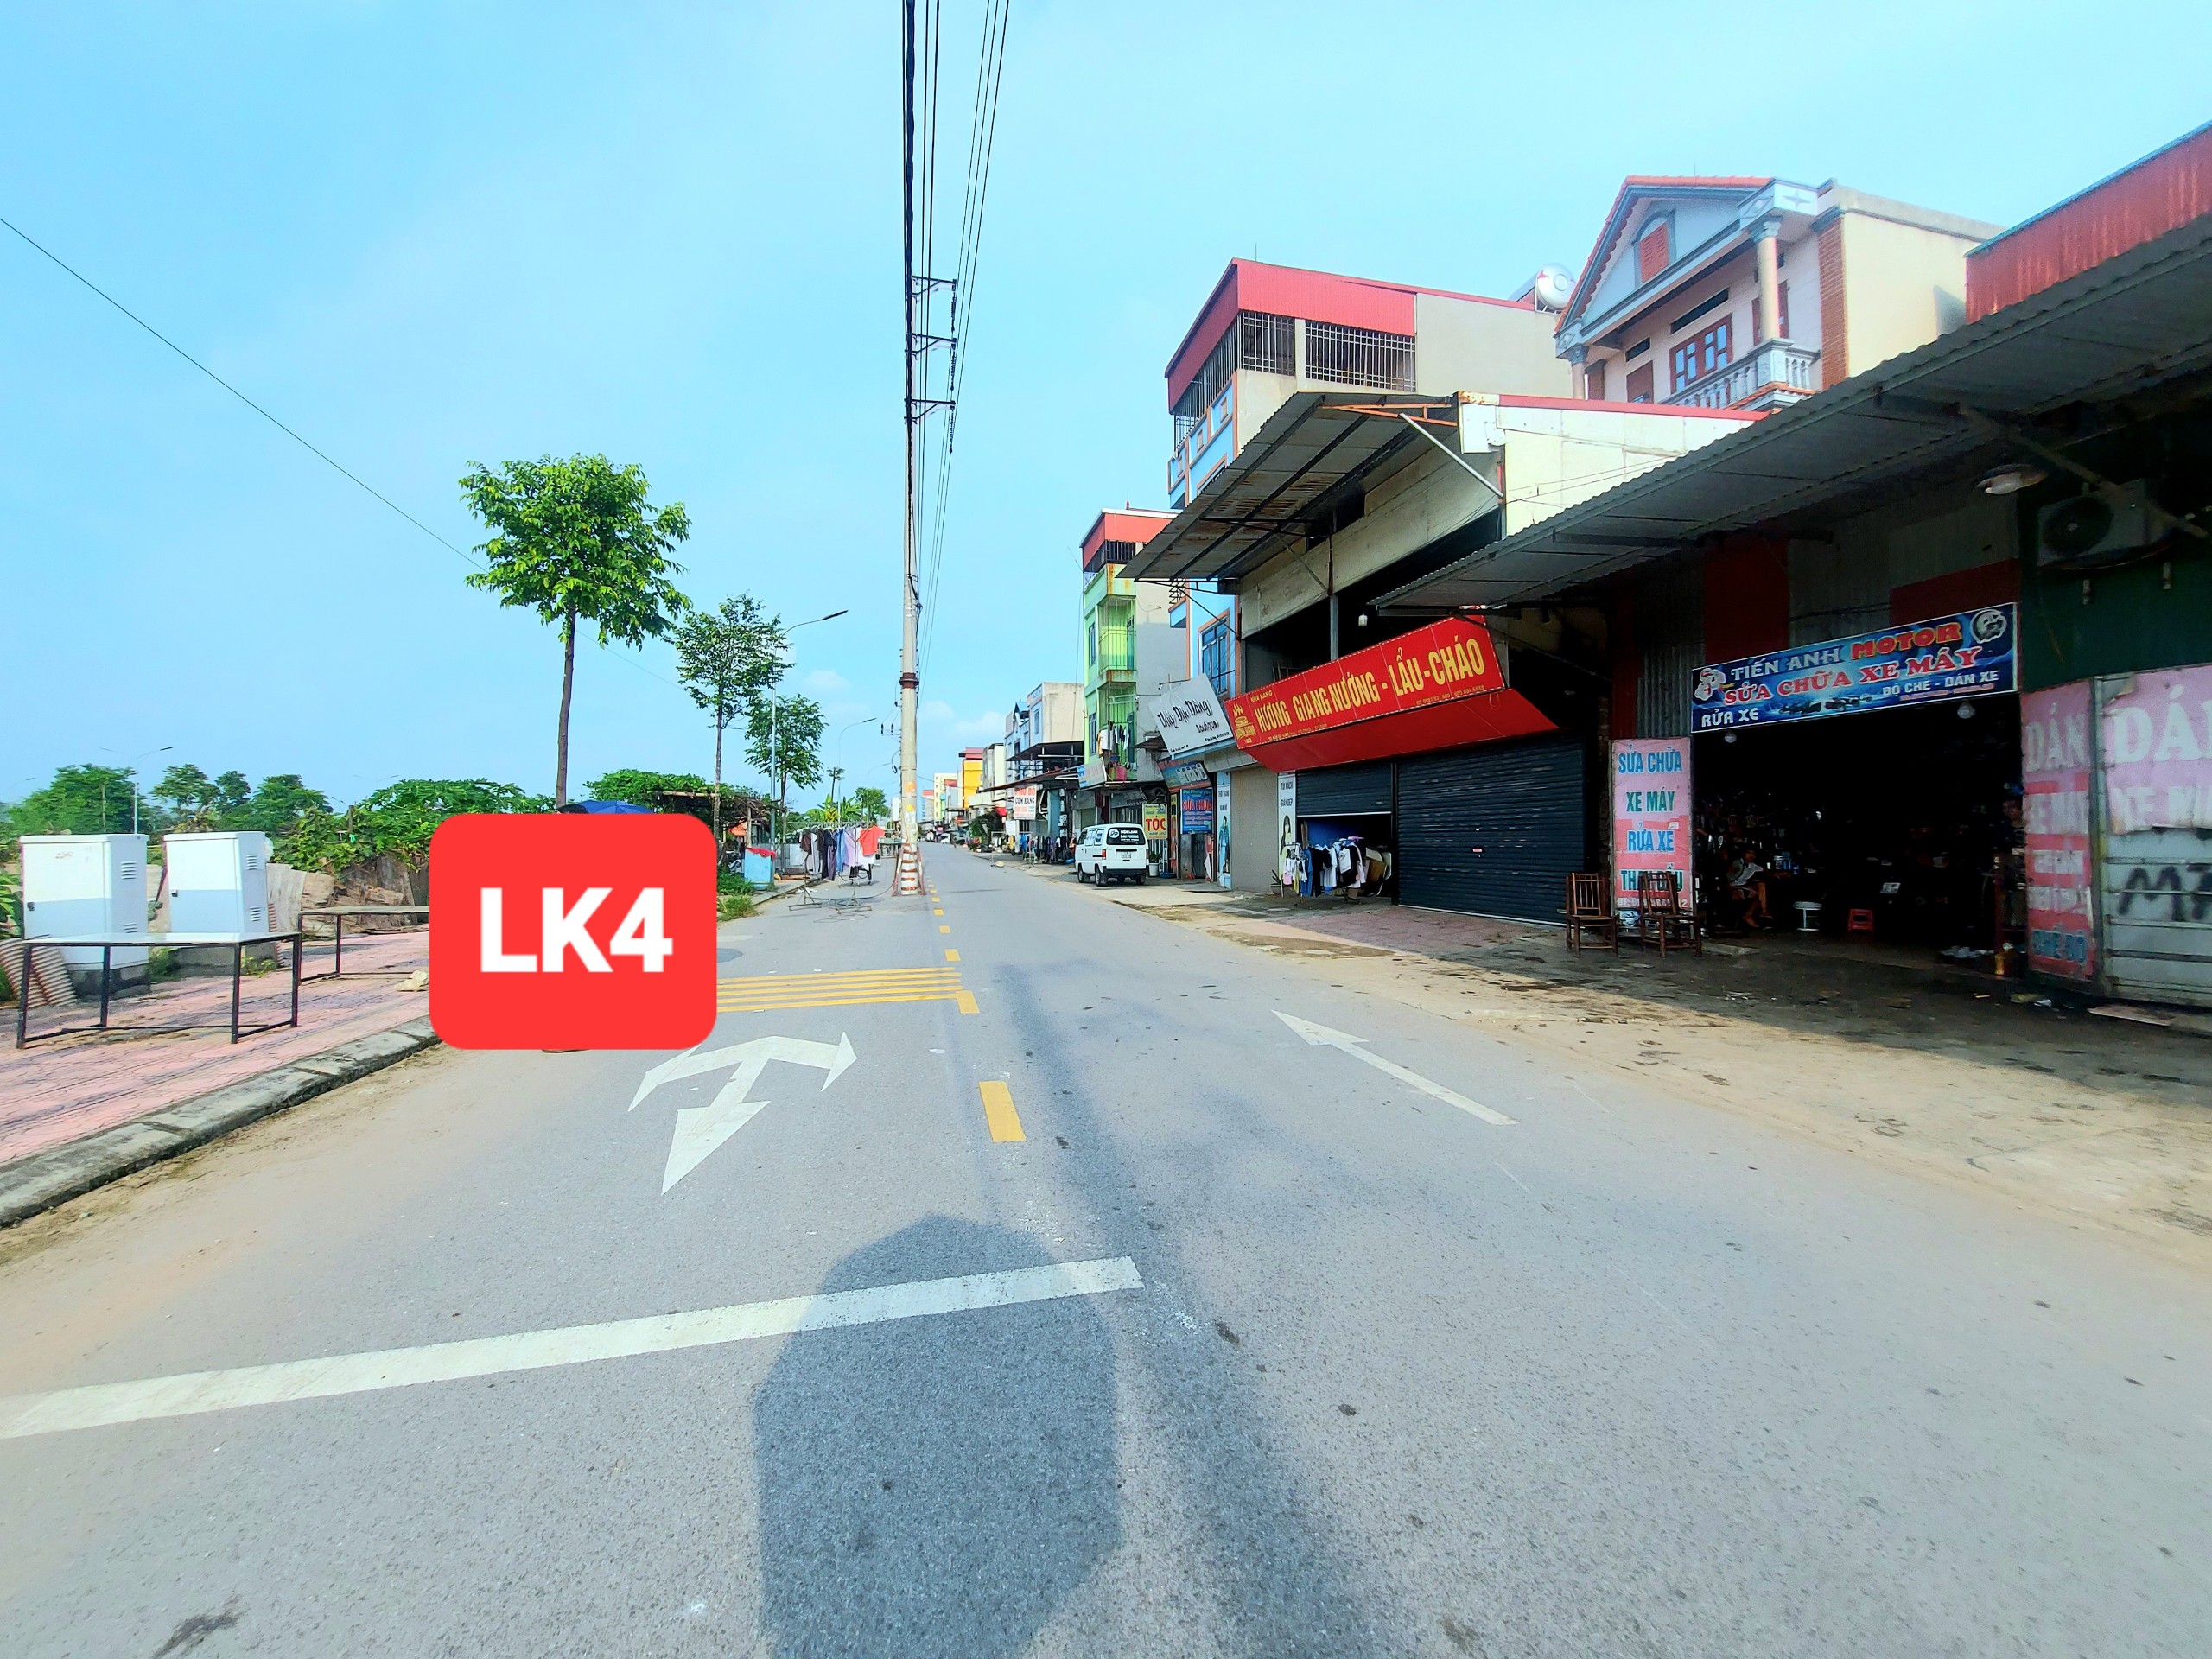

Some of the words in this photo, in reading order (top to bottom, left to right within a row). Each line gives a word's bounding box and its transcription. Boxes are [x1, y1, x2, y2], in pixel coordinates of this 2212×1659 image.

[1787, 648, 1840, 671] ANH
[1851, 622, 1962, 660] MOTOR
[1724, 680, 1772, 705] SỬA
[1777, 670, 1853, 696] CHỮA
[1859, 660, 1900, 683] XE
[1905, 646, 1982, 677] MÁY
[1980, 671, 1999, 683] XE
[1255, 700, 1292, 733] HƯƠNG
[1292, 687, 1332, 722] GIANG
[1328, 670, 1381, 713] NƯỚNG
[1701, 709, 1733, 728] RỬA
[1738, 708, 1759, 722] XE
[1618, 744, 1644, 774] SỬA
[1647, 746, 1682, 772] CHỮA
[1626, 791, 1643, 812] XE
[1646, 786, 1675, 812] MÁY
[1145, 815, 1166, 832] TÓC
[1628, 822, 1654, 852] RỬA
[1657, 830, 1675, 852] XE
